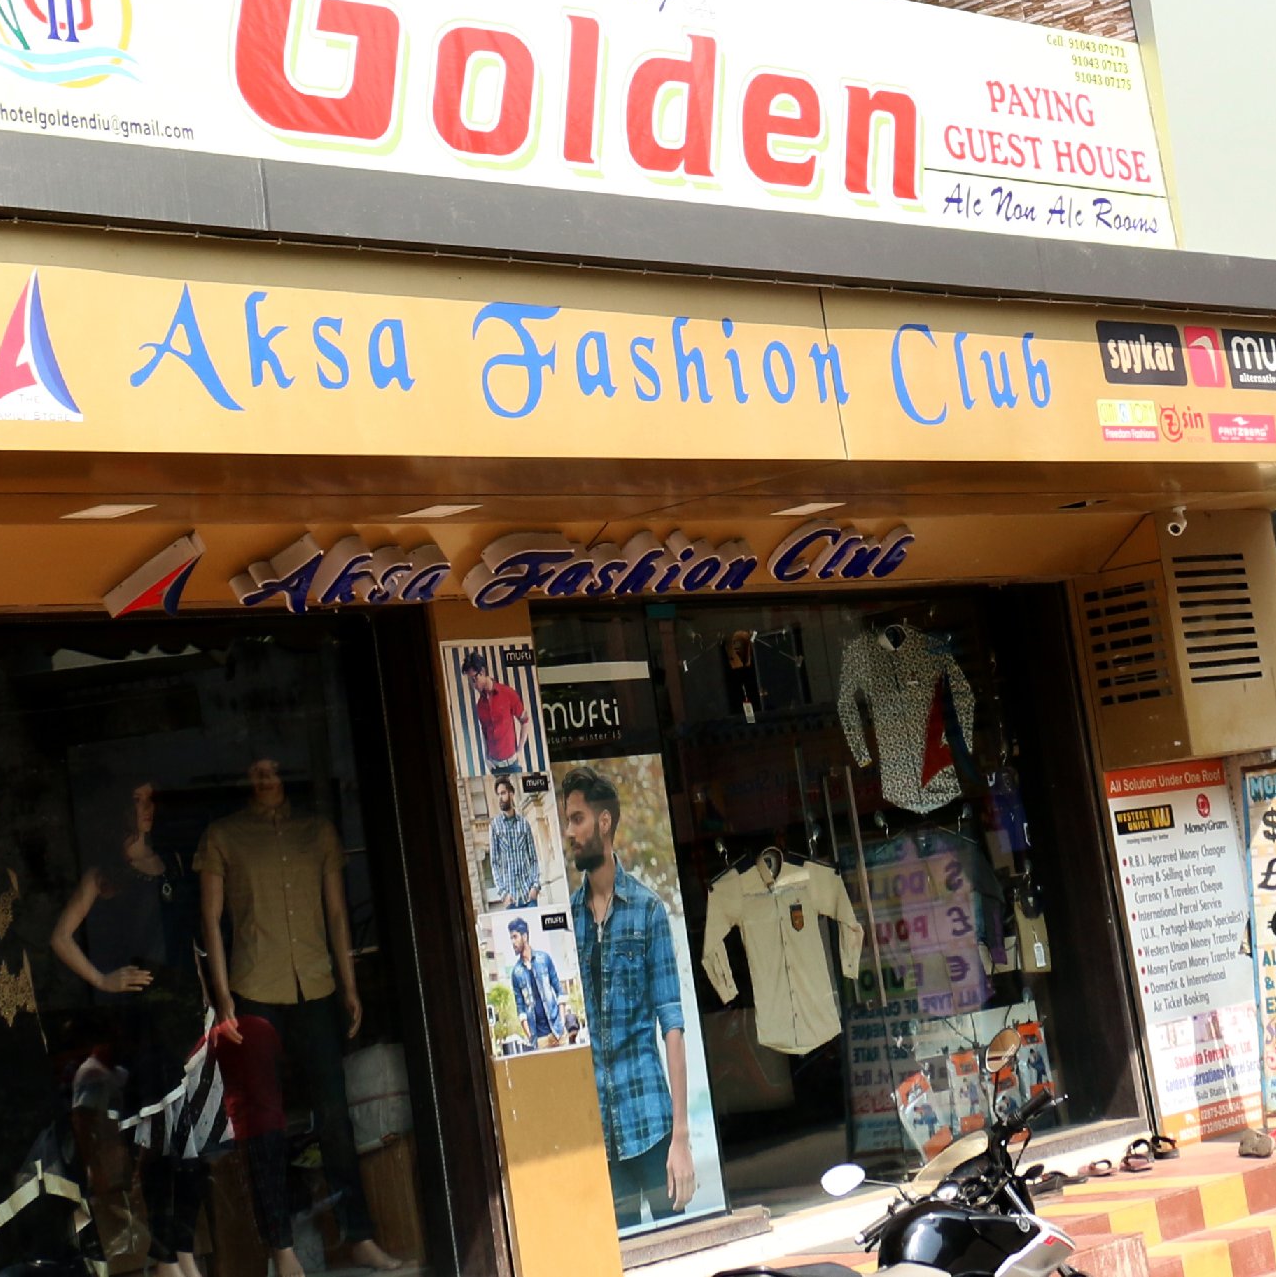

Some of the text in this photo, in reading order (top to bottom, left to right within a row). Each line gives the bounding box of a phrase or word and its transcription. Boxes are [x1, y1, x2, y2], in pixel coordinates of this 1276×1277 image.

[1069, 38, 1097, 53] 91043
[1098, 43, 1125, 58] 07171
[1072, 54, 1129, 74] 91043 07173
[1075, 71, 1132, 91] 91043 07175
[986, 80, 1095, 127] PAYING
[0, 102, 195, 140] hotelgoldendiu@gmail.com
[943, 124, 1153, 184] GUEST HOUSE
[990, 186, 1037, 223] Non
[1092, 197, 1159, 234] Rooms
[129, 281, 1053, 425] Aksa Fashion Club
[1107, 333, 1176, 374] spykar
[1182, 406, 1205, 429] sin
[235, 523, 915, 613] Aksa Fashion Club
[547, 735, 573, 744] utumn
[1109, 768, 1221, 793] All Solution Under One Roof
[1116, 810, 1149, 823] WESTERN
[1148, 852, 1178, 867] Approved
[1179, 849, 1199, 862] Money
[1201, 844, 1226, 858] Changer
[1131, 874, 1154, 886] Buying
[1162, 867, 1183, 881] Selling
[1184, 867, 1191, 877] of
[1192, 864, 1216, 877] Foreign
[1134, 891, 1162, 905] Currency
[1200, 880, 1223, 893] Cheque
[1138, 898, 1222, 922] International Parcel Service
[1143, 929, 1238, 958] Western Union Money Transfer
[1147, 947, 1236, 976] Money Gram Money Transfer
[1149, 979, 1179, 995] Domestic
[1186, 966, 1226, 986] International
[1264, 976, 1275, 990] &
[1153, 990, 1210, 1012] Air Ticket Booking
